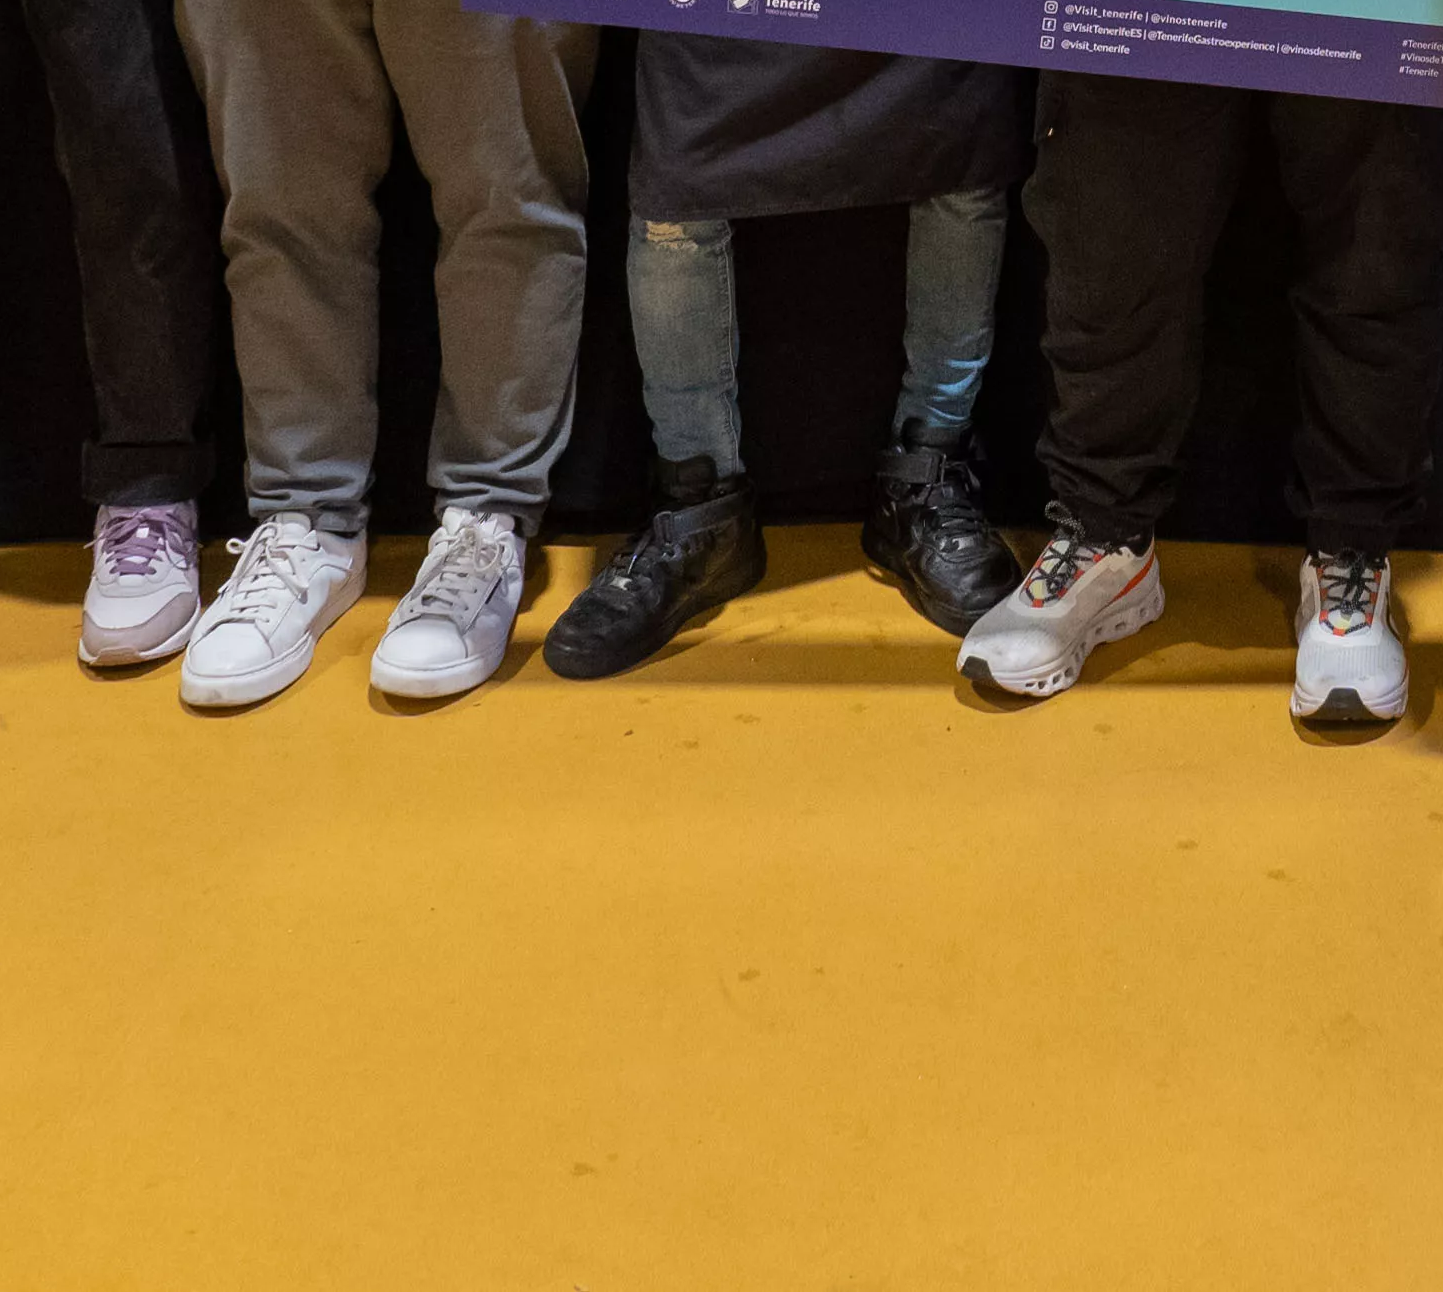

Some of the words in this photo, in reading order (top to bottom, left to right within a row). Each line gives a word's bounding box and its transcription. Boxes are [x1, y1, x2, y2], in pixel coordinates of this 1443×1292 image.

[1065, 4, 1144, 21] @Visit_tenerife
[1151, 13, 1228, 30] @vinostenerife
[1060, 38, 1131, 55] @visit_tenerife
[1063, 22, 1143, 39] @VisitTenerifeES
[1148, 30, 1276, 53] @TenerifeGastroexperience
[1280, 43, 1362, 61] @vinosdetenerife
[1399, 65, 1439, 78] #Tenerife
